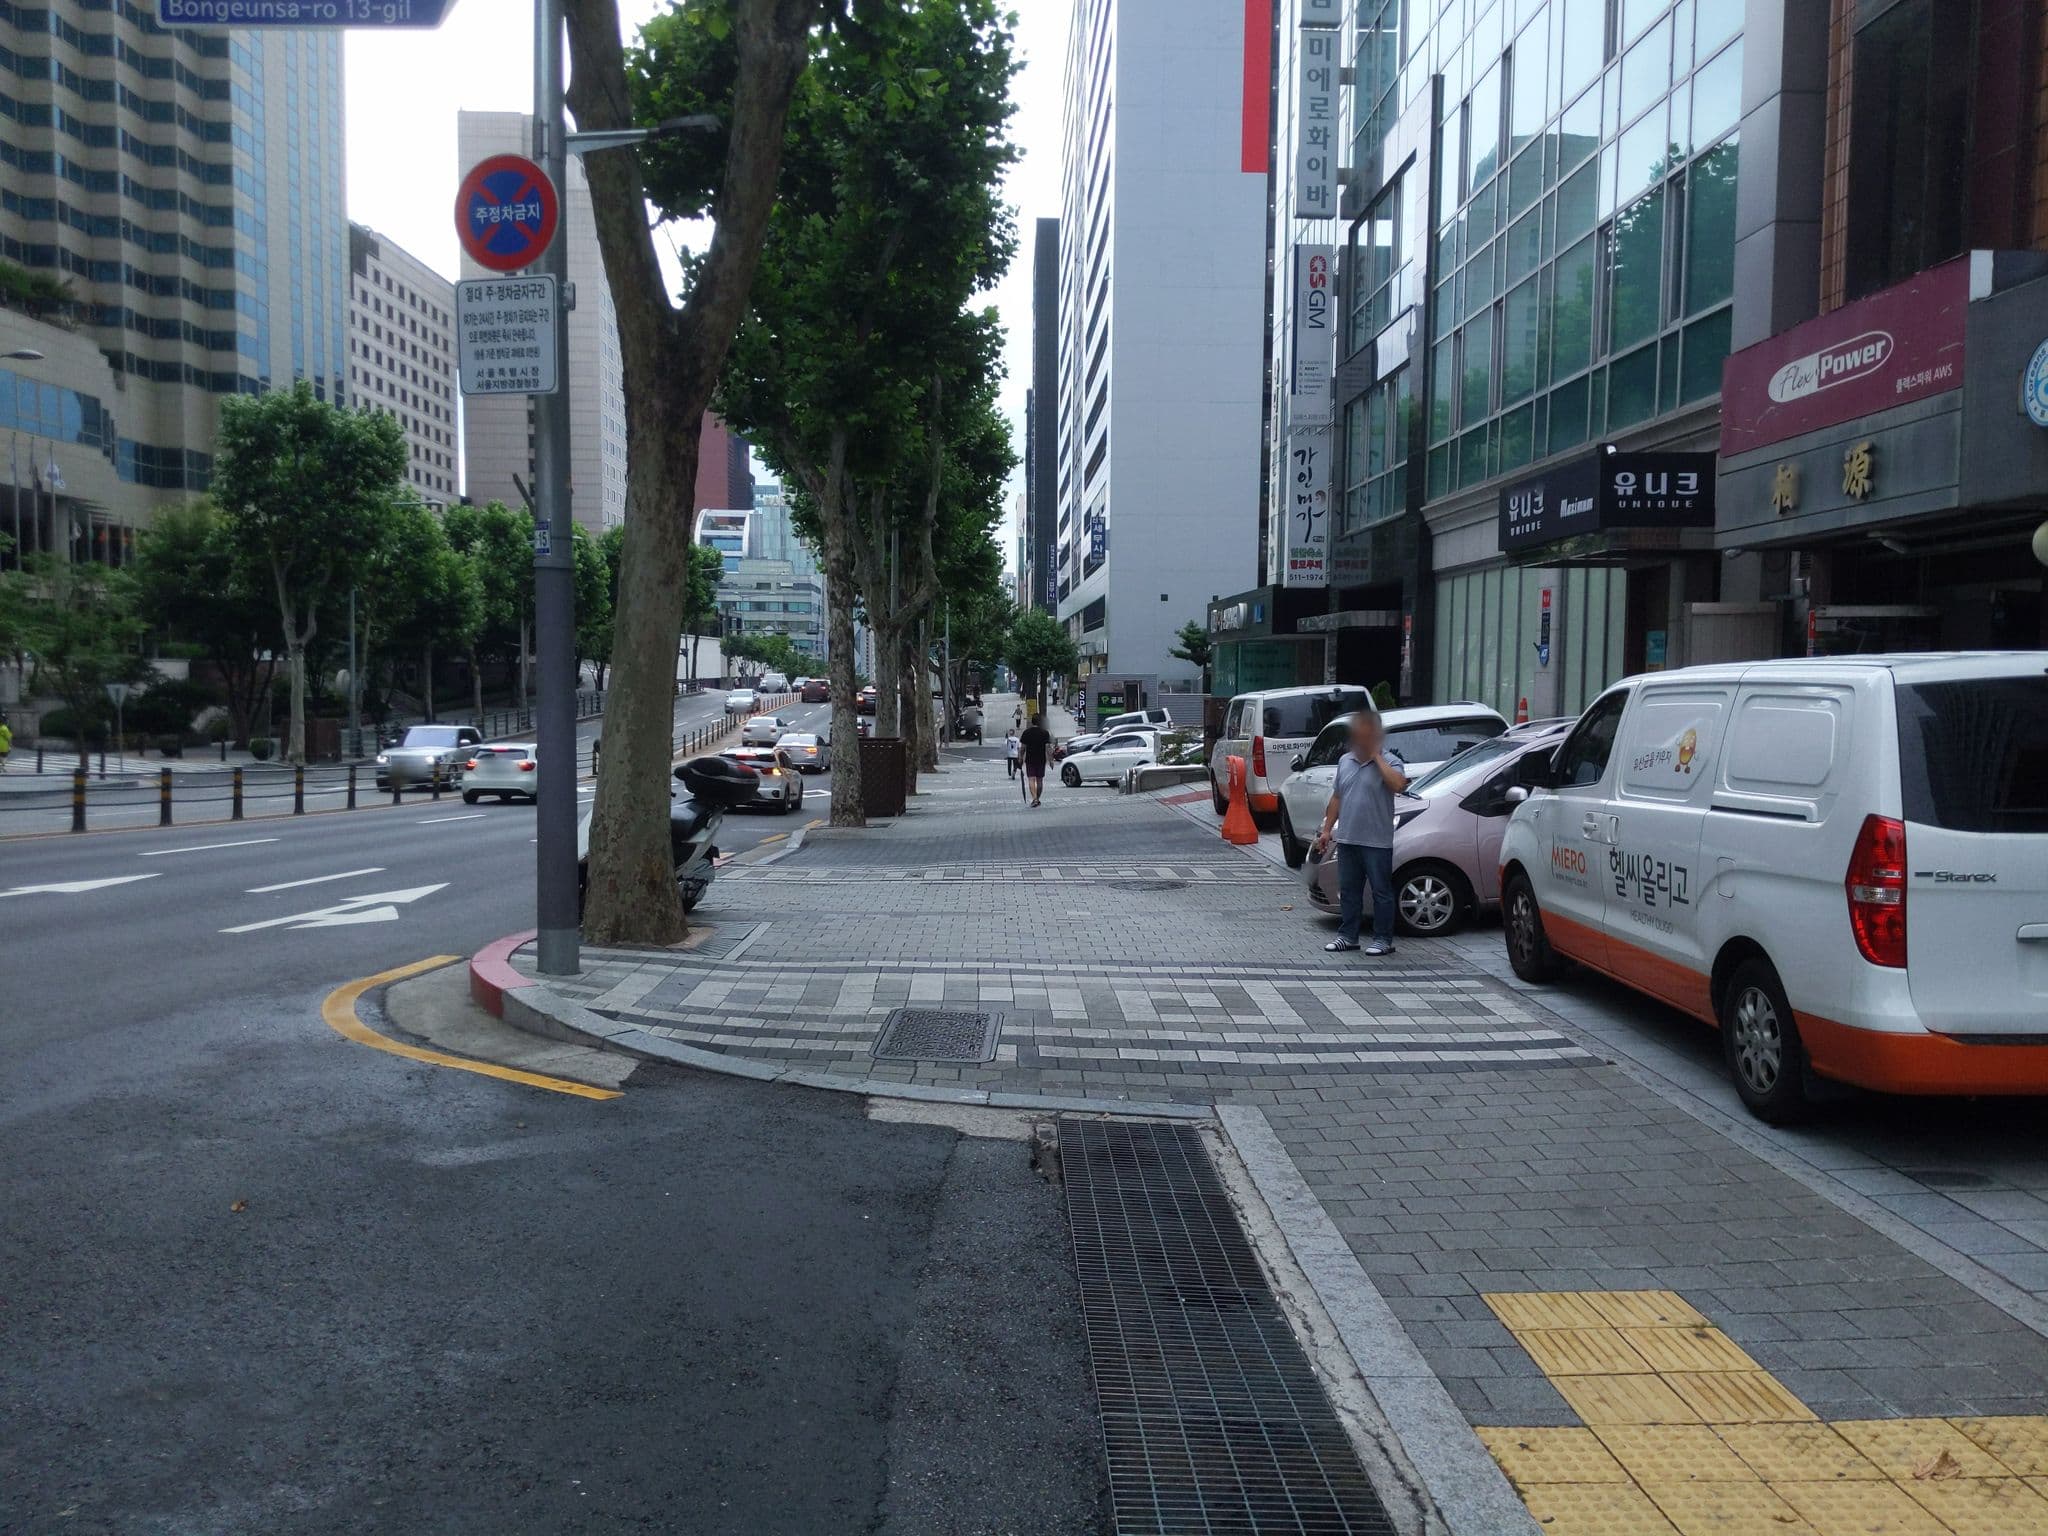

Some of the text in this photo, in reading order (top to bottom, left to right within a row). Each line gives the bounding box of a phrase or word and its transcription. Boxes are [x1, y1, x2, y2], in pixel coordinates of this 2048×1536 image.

[168, 0, 411, 21] Bongeunsa-ro 13-gil
[1306, 37, 1332, 209] 미에로화이바
[475, 201, 540, 224] 주정차금지
[465, 287, 482, 302] 절대
[1819, 340, 1886, 379] Power
[1934, 363, 1953, 380] AWS
[1613, 472, 1699, 496] 유니크
[1508, 487, 1545, 522] 유니크
[1619, 500, 1693, 508] UNIQUE
[1510, 520, 1542, 537] UNIQUE
[1552, 845, 1586, 875] MIERO
[1609, 847, 1689, 908] 헬씨올리고
[1935, 870, 1997, 883] Starex
